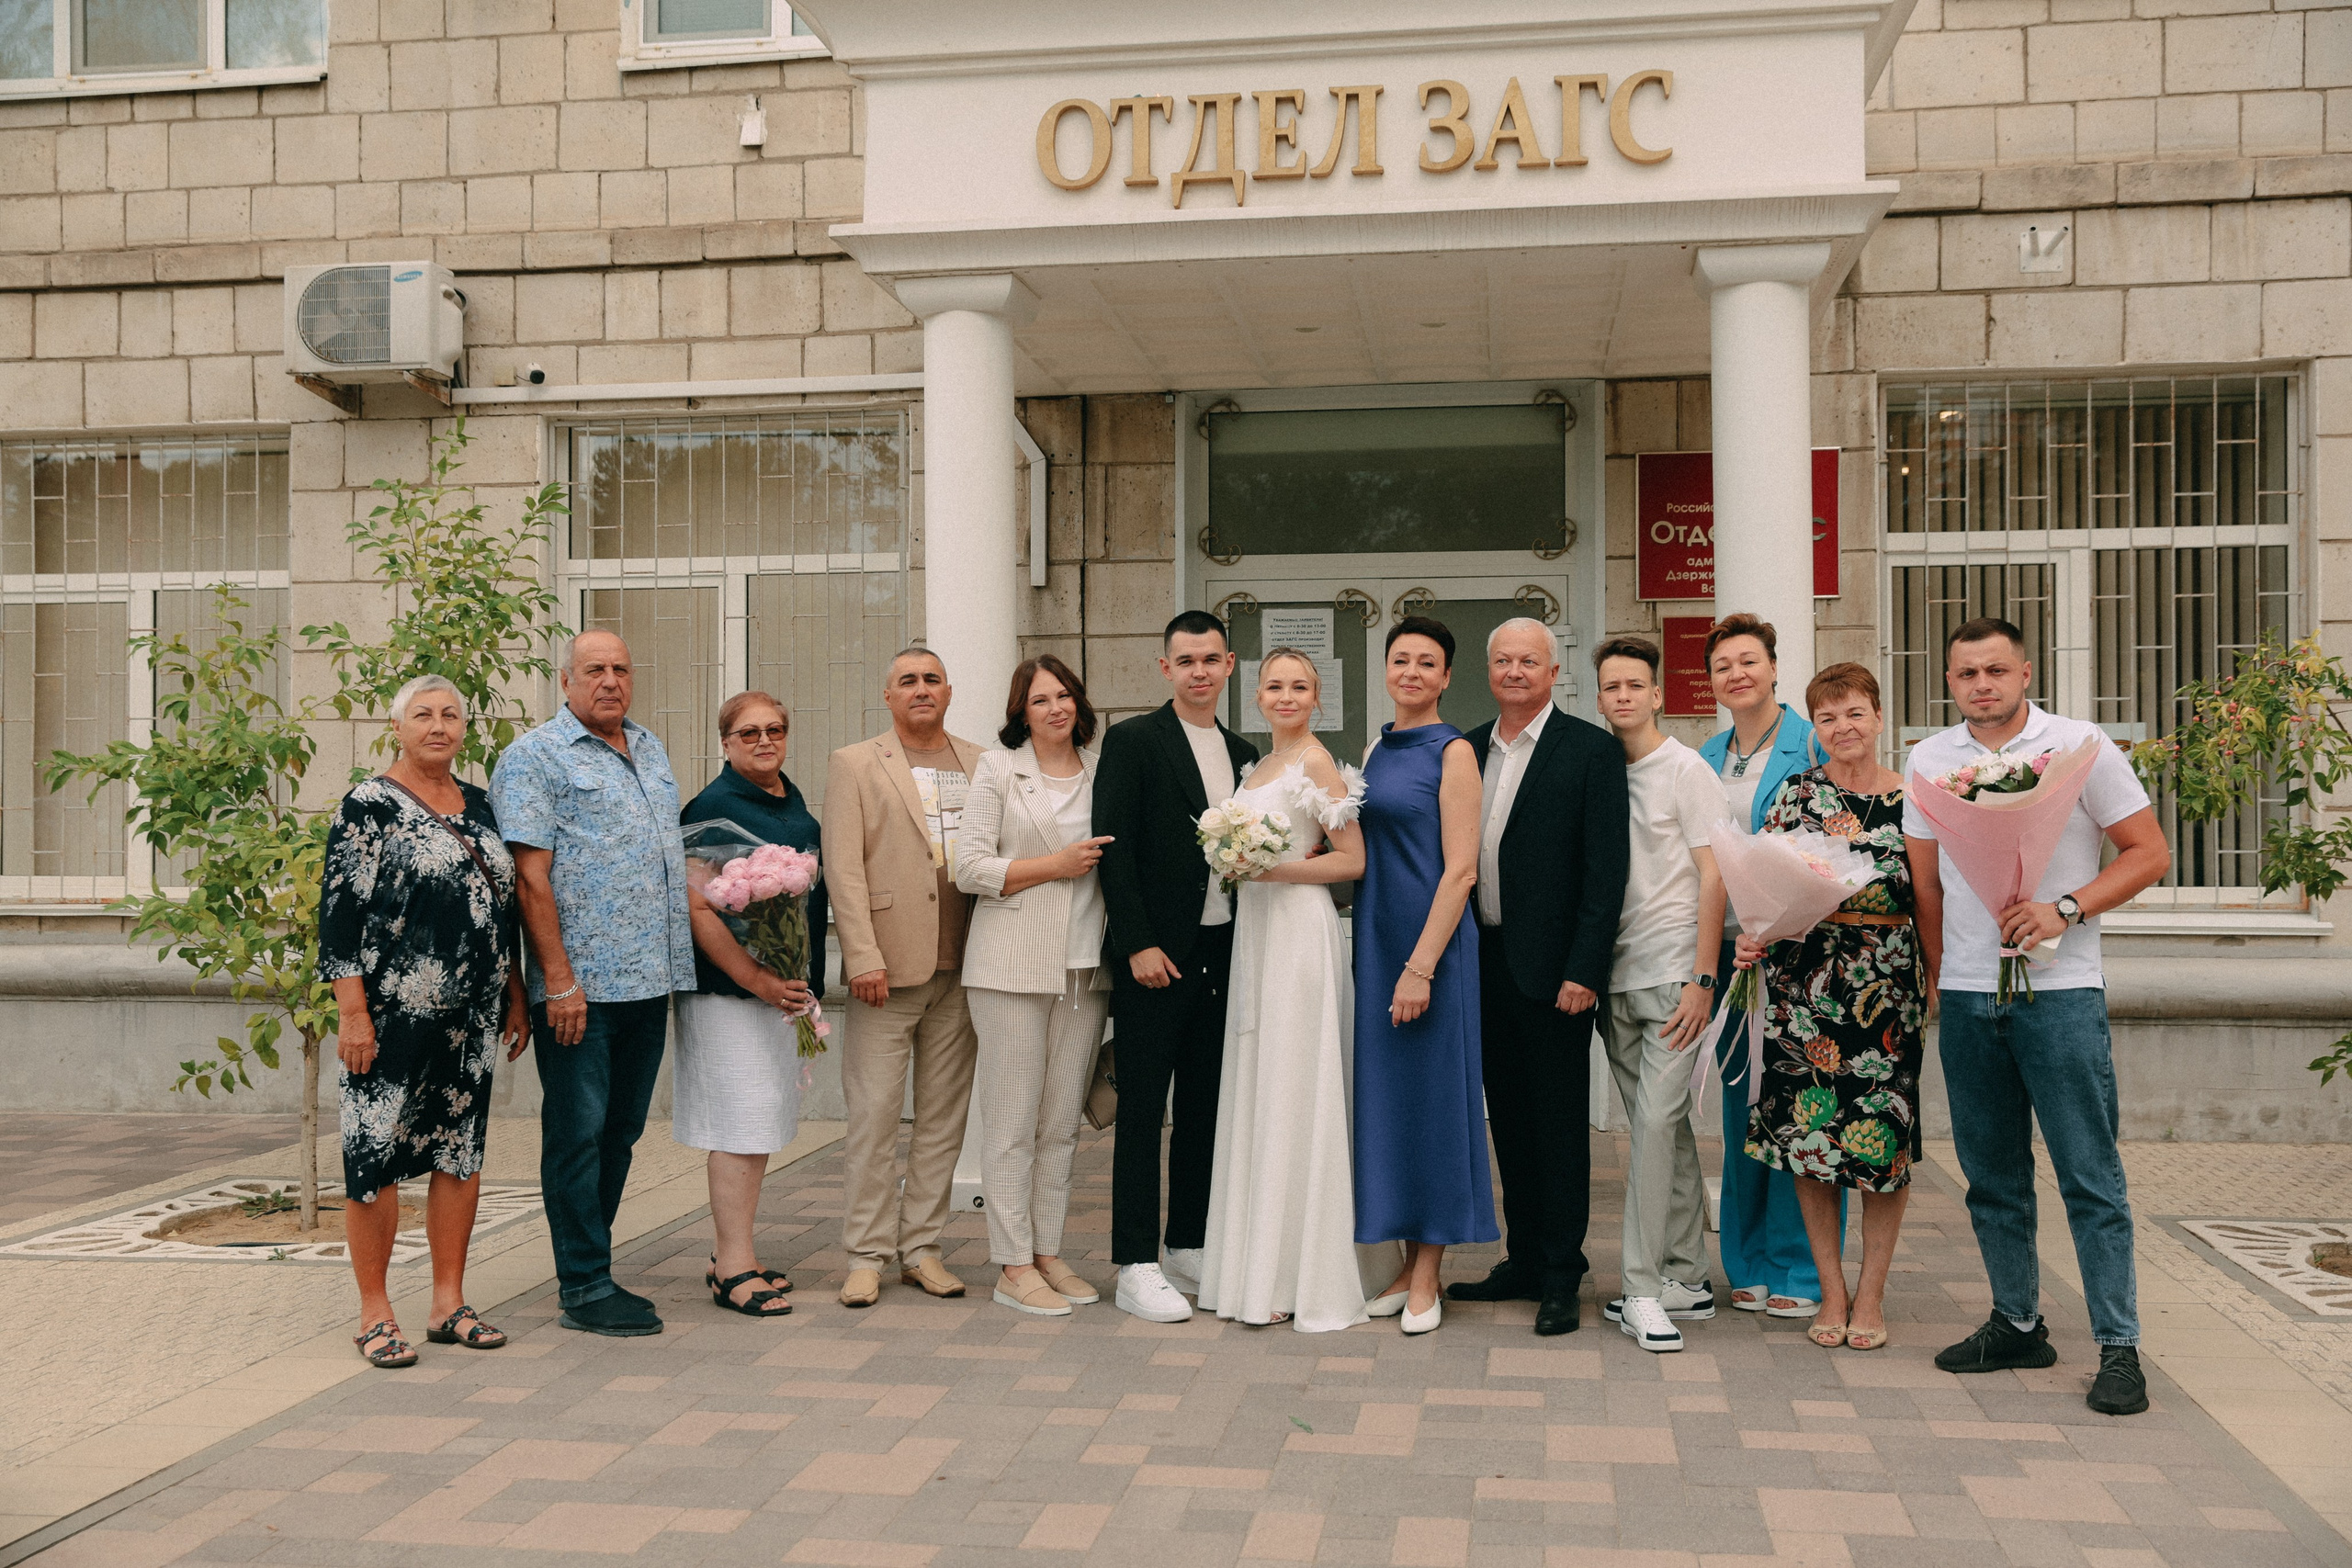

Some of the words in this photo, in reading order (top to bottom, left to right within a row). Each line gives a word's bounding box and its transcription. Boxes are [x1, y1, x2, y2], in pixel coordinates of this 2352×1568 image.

[1035, 85, 1384, 209] ОТДЕЛ
[1418, 69, 1674, 174] ЗАГС
[1687, 558, 1714, 567] адм
